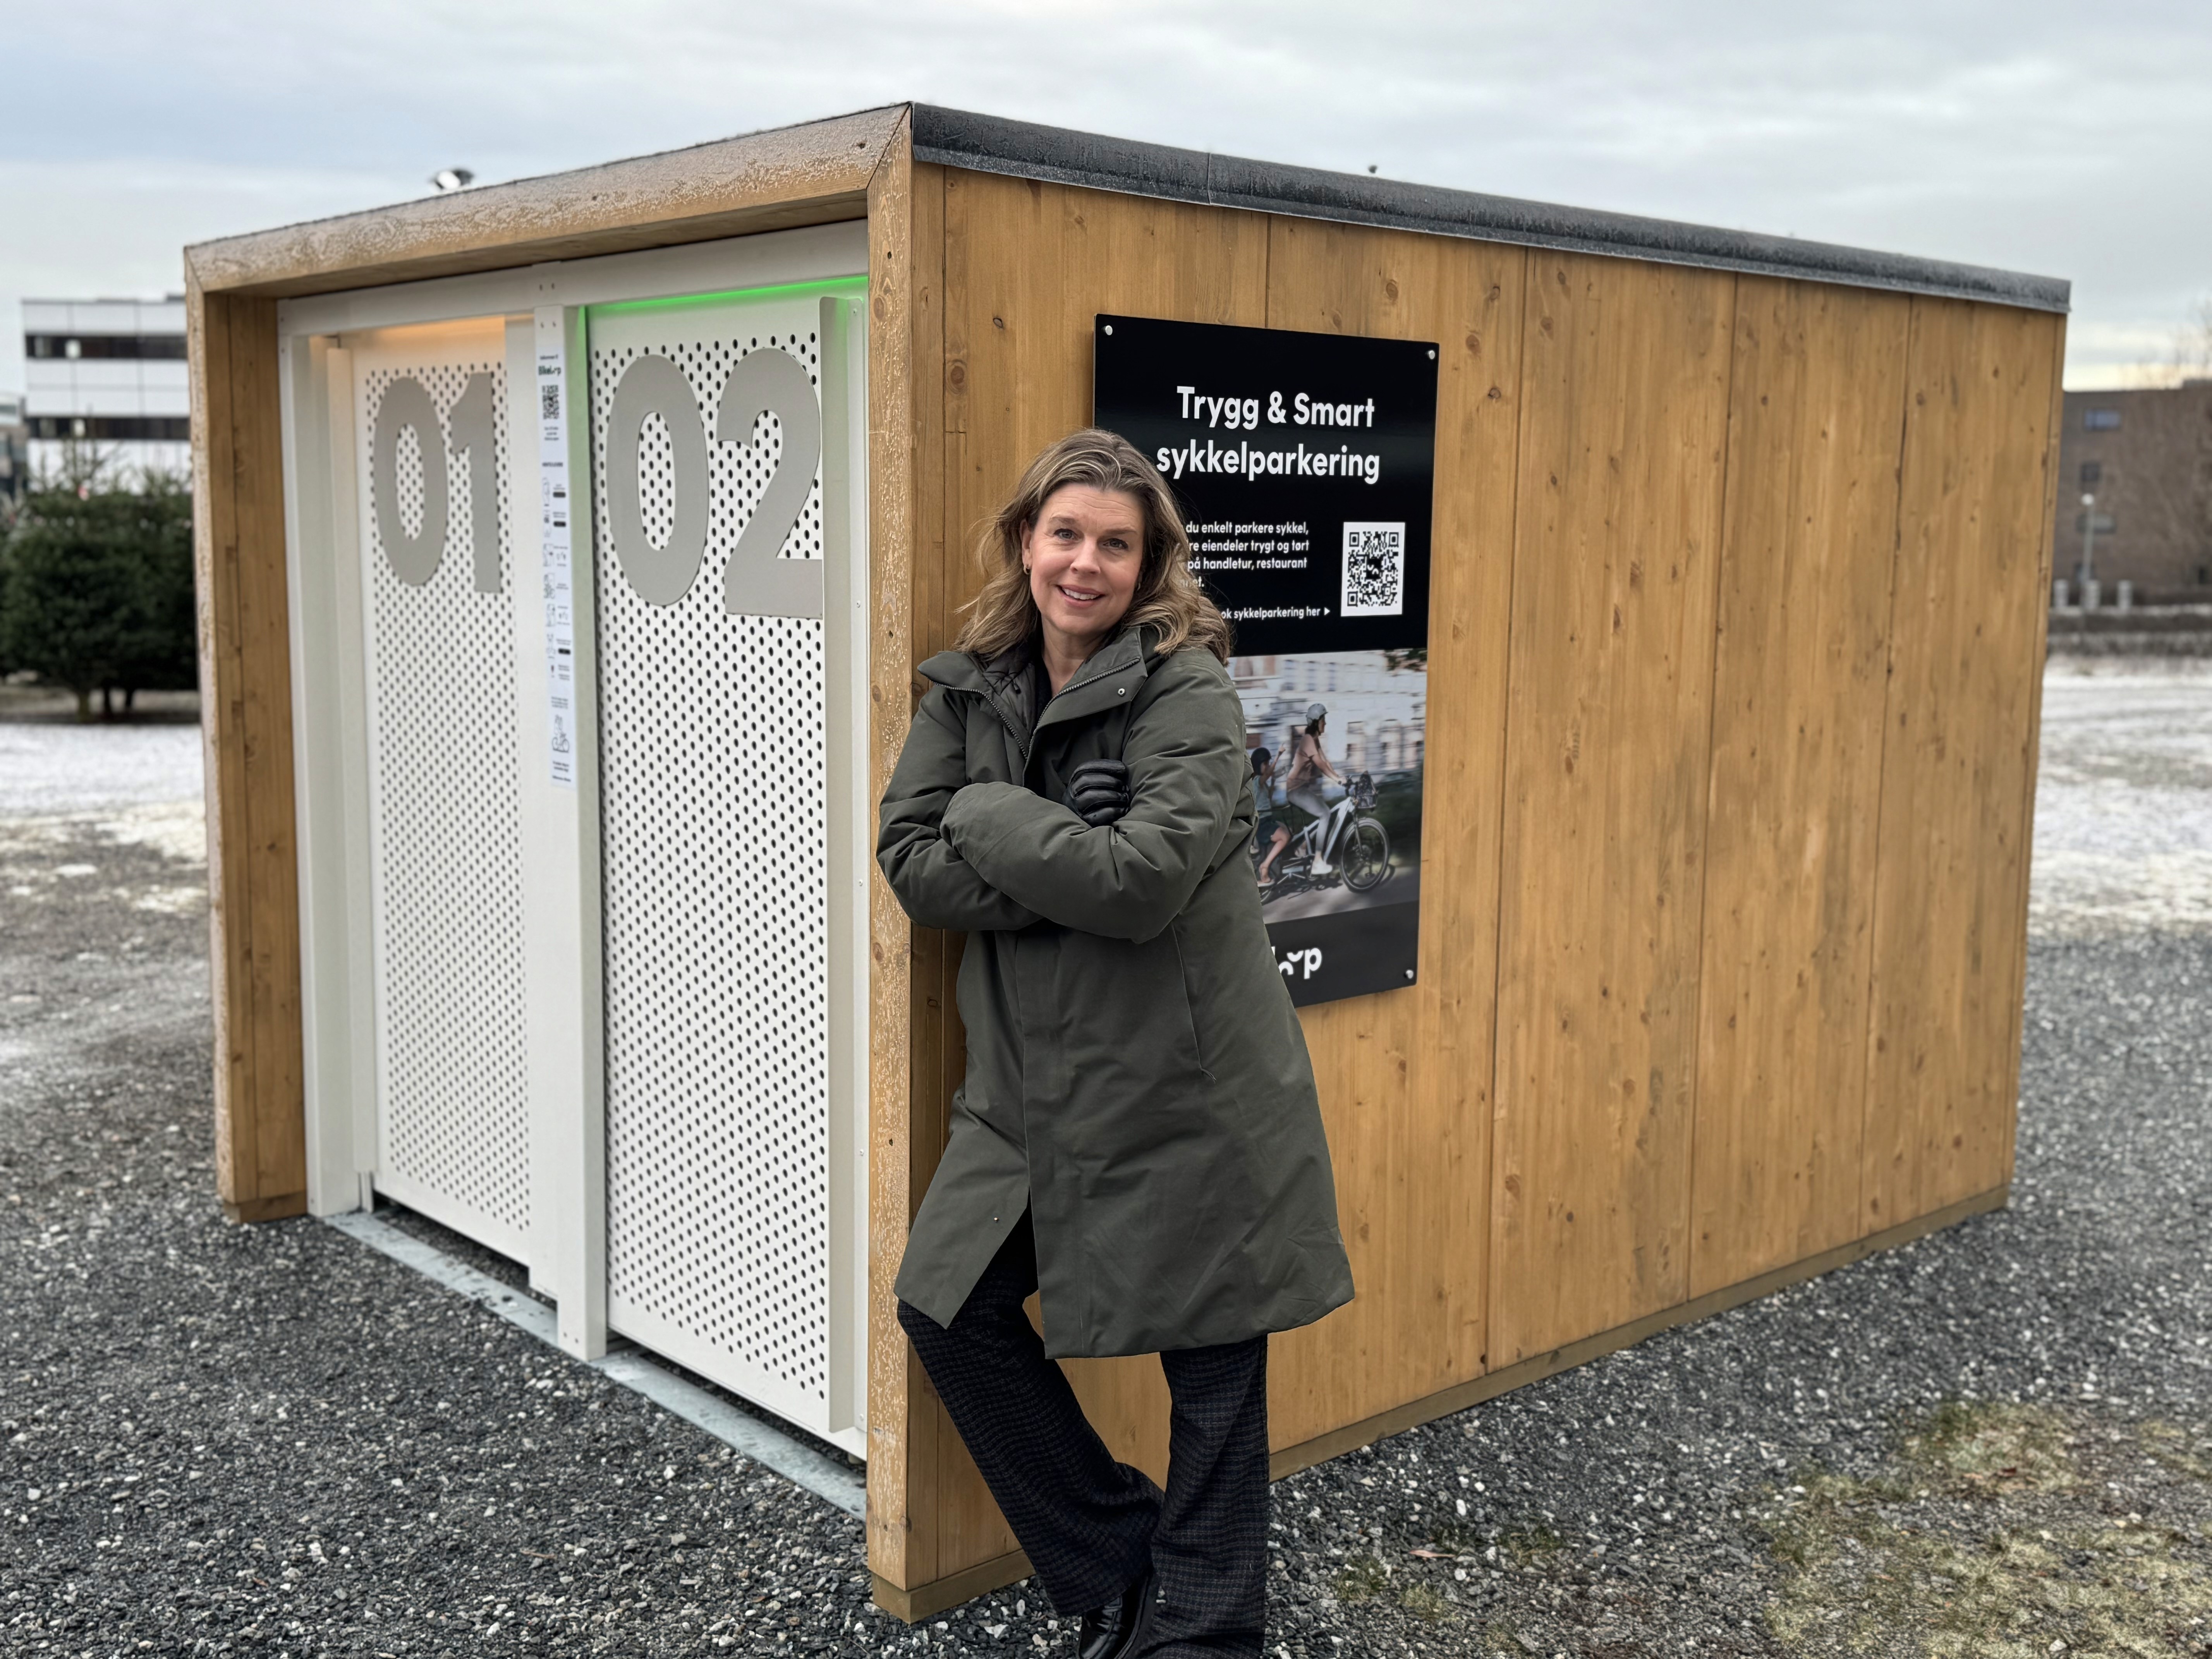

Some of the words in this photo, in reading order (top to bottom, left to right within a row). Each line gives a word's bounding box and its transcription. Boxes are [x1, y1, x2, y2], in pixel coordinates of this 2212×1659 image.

[1176, 386, 1259, 430] Trygg
[1267, 391, 1286, 424] &
[1293, 392, 1375, 427] Smart
[1156, 439, 1380, 484] sykkelparkering
[373, 371, 502, 594] 01
[606, 347, 823, 619] 02
[1185, 521, 1199, 533] du
[1201, 521, 1233, 533] enkelt
[1235, 521, 1274, 536] parkere
[1276, 521, 1309, 536] sykkel,
[1201, 539, 1249, 551] eiendeler
[1251, 540, 1275, 554] trygt
[1277, 542, 1289, 553] og
[1291, 540, 1309, 551] tørt
[1187, 556, 1200, 572] på
[1203, 557, 1254, 570] handletur,
[1257, 557, 1307, 568] restaurant
[1234, 606, 1304, 621] sykkelparkering
[1306, 606, 1321, 616] her
